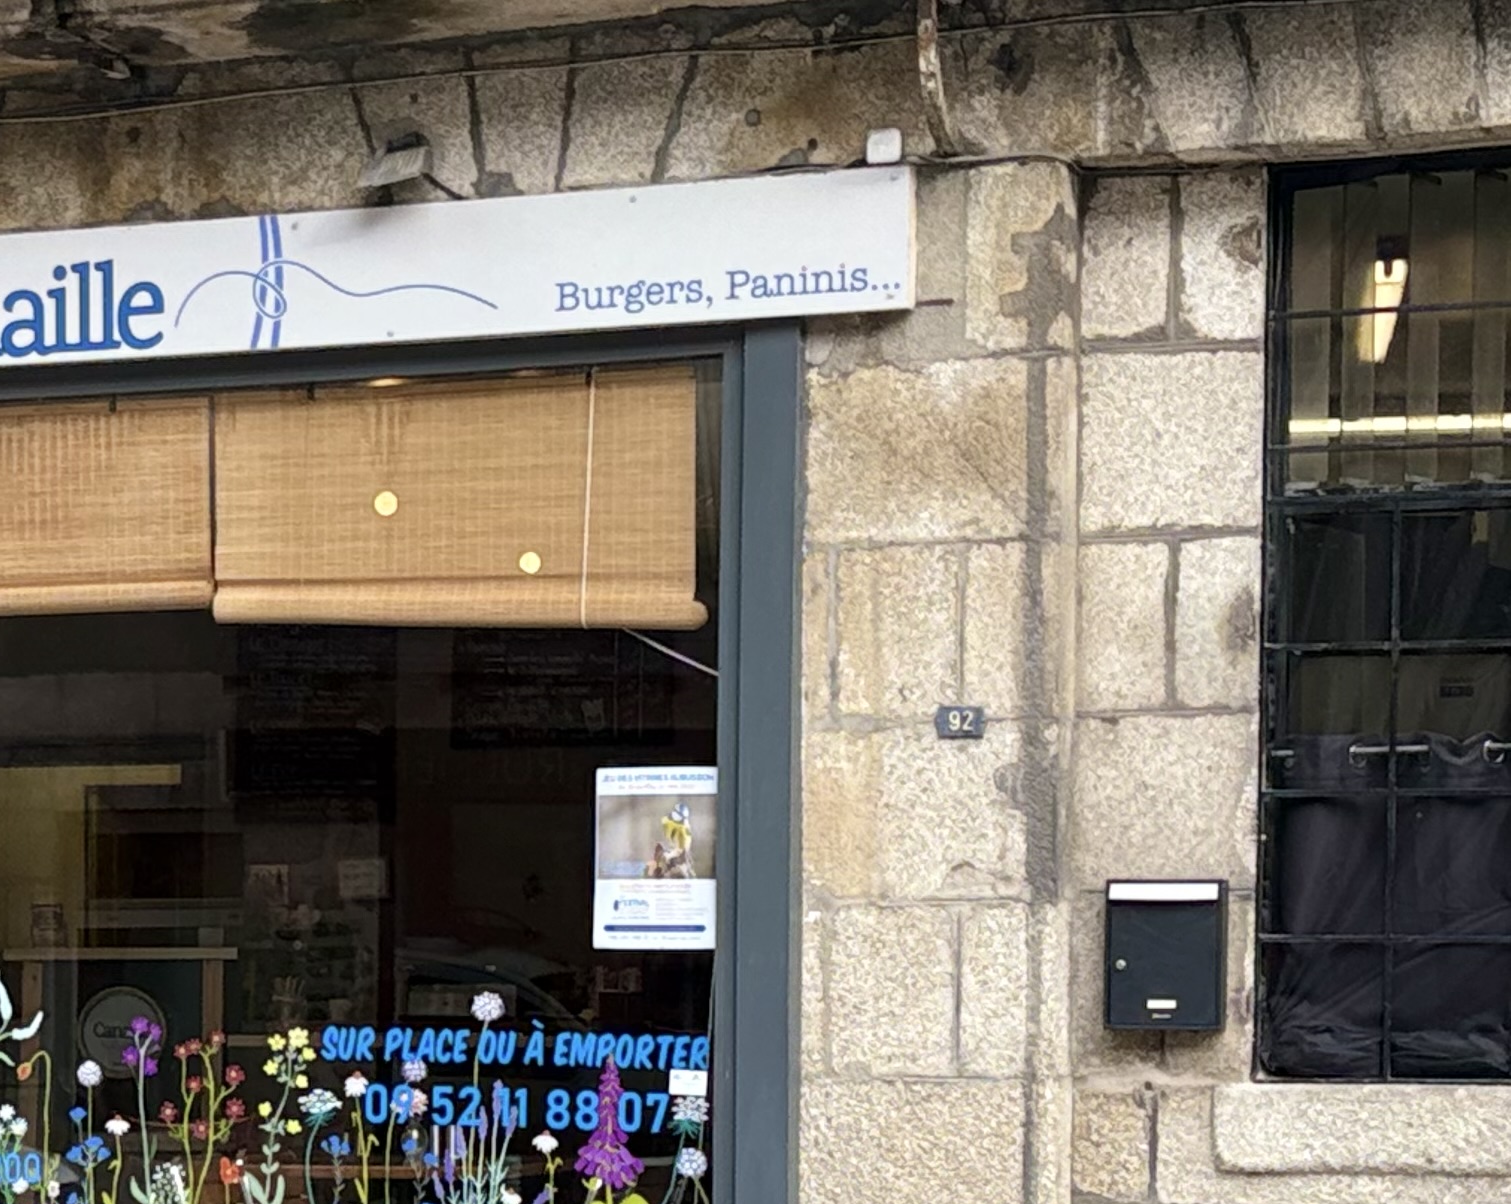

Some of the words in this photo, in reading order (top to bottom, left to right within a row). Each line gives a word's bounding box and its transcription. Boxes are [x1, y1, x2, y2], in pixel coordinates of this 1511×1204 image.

[554, 277, 714, 314] Burgers,
[724, 262, 901, 301] Paninis...
[948, 710, 974, 731] 92
[320, 1025, 374, 1062] SUR
[383, 1026, 472, 1064] PLACE
[477, 1029, 518, 1066] OU
[524, 1018, 546, 1067] À
[552, 1033, 710, 1071] EMPORTER
[365, 1083, 414, 1125] 09
[431, 1085, 482, 1127] 52
[497, 1086, 528, 1128] 11
[546, 1088, 599, 1132] 88
[616, 1090, 670, 1134] 07
